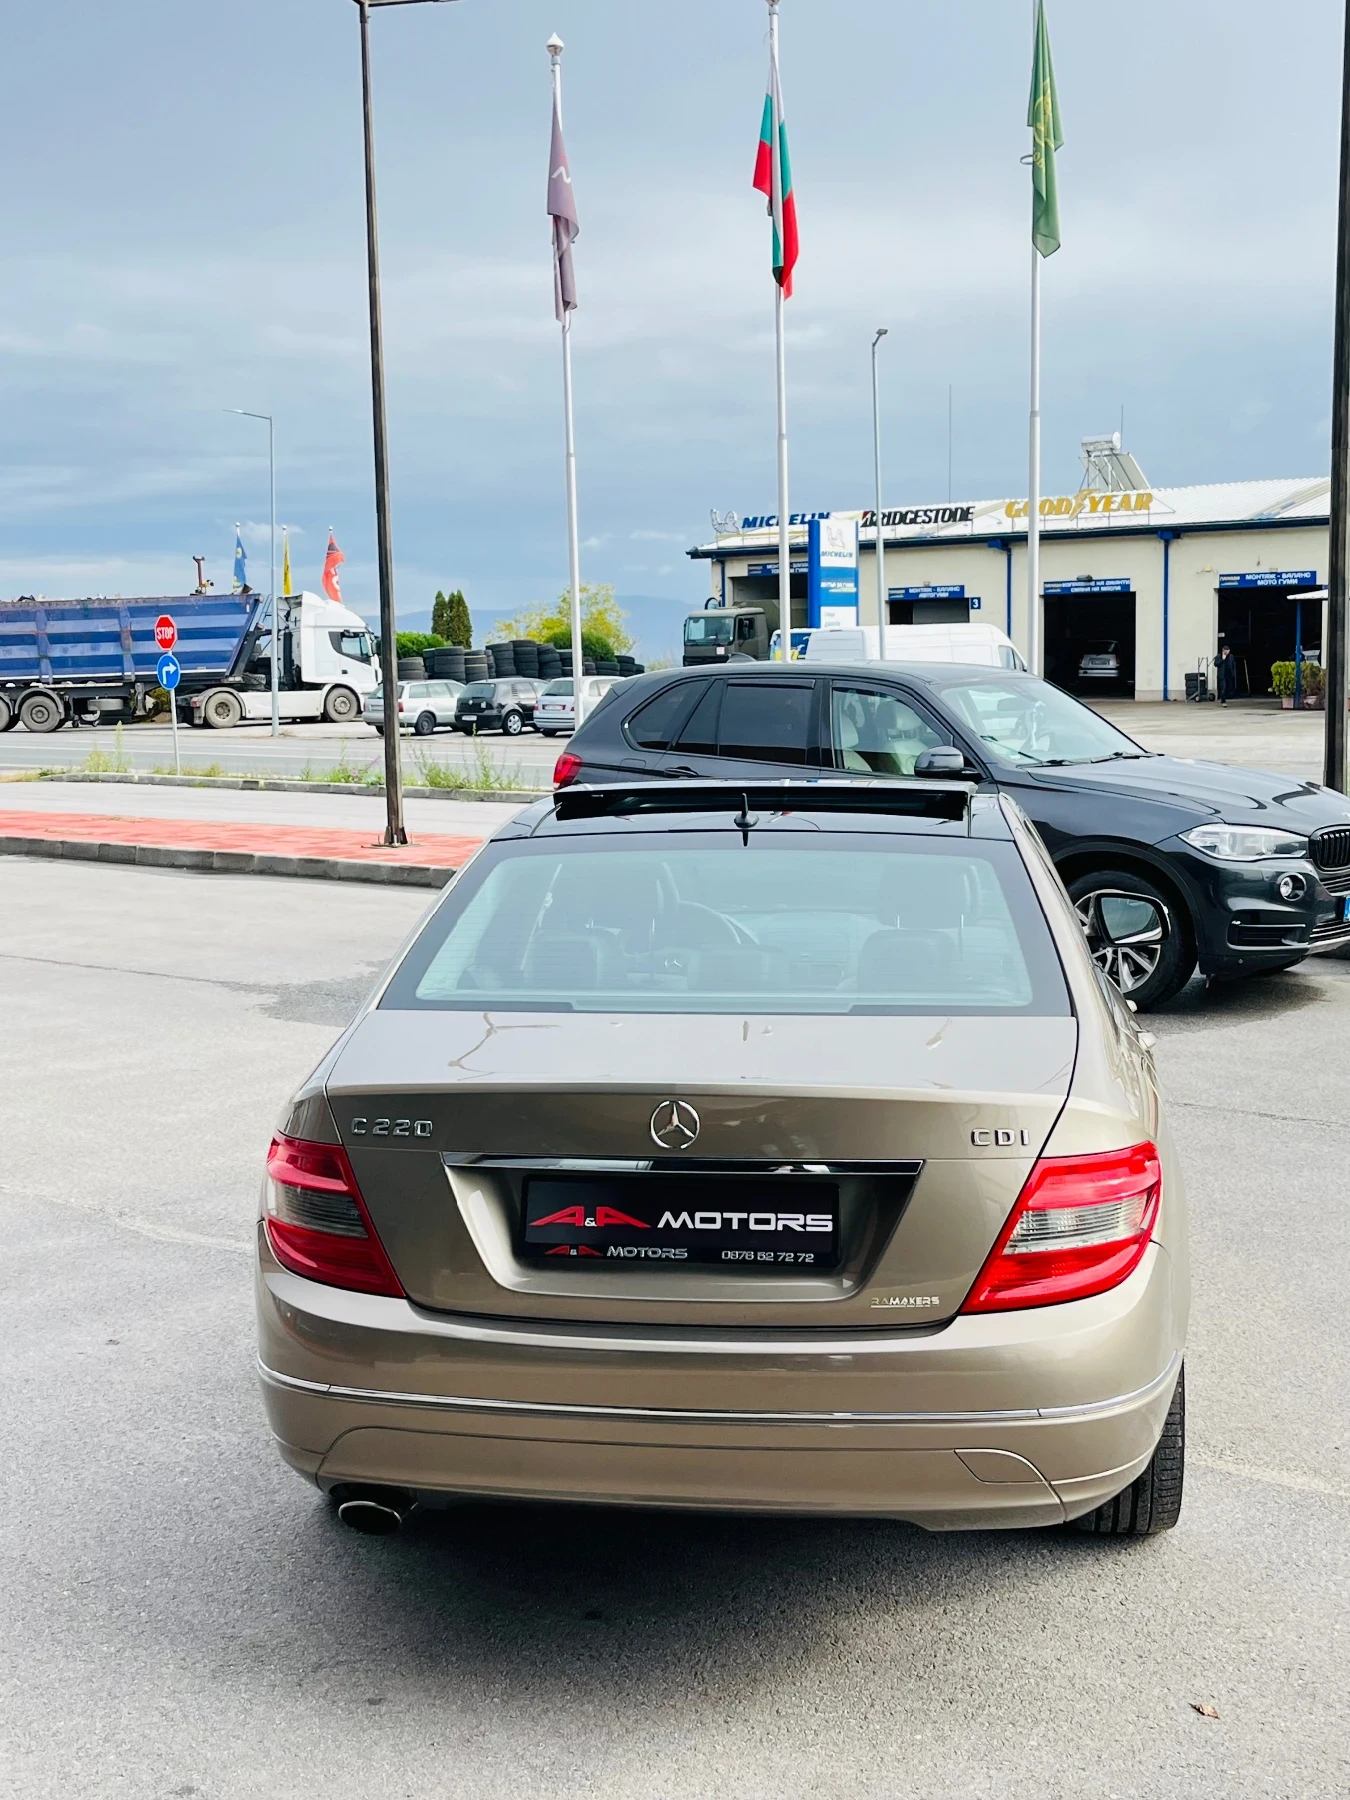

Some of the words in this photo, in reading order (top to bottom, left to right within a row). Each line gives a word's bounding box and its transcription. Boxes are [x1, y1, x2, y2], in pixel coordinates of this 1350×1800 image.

[742, 512, 830, 529] MICELIN
[860, 506, 975, 528] BRIDGESTONE
[821, 550, 853, 558] MICHELIN
[972, 599, 979, 608] 3
[156, 627, 174, 639] STOP
[351, 1117, 367, 1134] C
[372, 1118, 433, 1137] 220
[970, 1128, 1030, 1146] CDI
[657, 1211, 833, 1232] MOTORS
[606, 1246, 688, 1259] MOTORS
[777, 1252, 794, 1262] 72
[797, 1253, 814, 1263] 72
